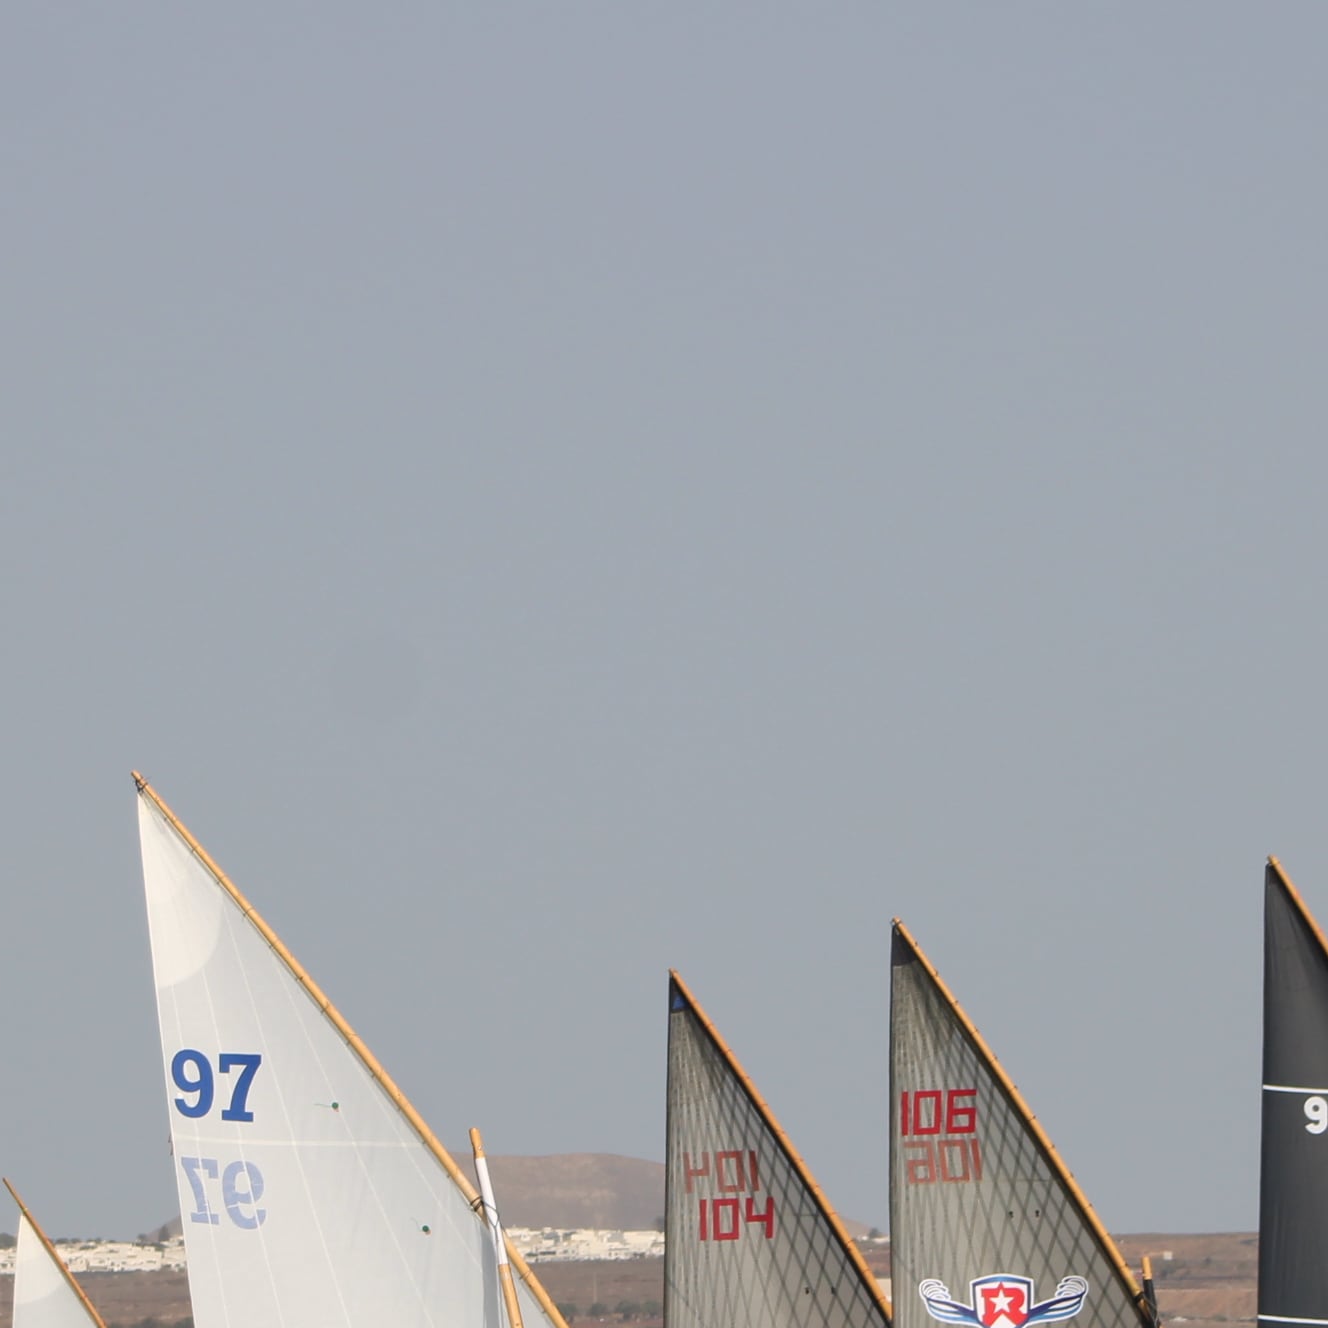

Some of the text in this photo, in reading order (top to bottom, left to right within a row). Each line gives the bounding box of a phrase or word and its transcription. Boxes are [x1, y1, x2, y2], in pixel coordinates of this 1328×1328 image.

[171, 1048, 262, 1122] 97
[901, 1088, 977, 1136] 106
[699, 1196, 774, 1241] 104
